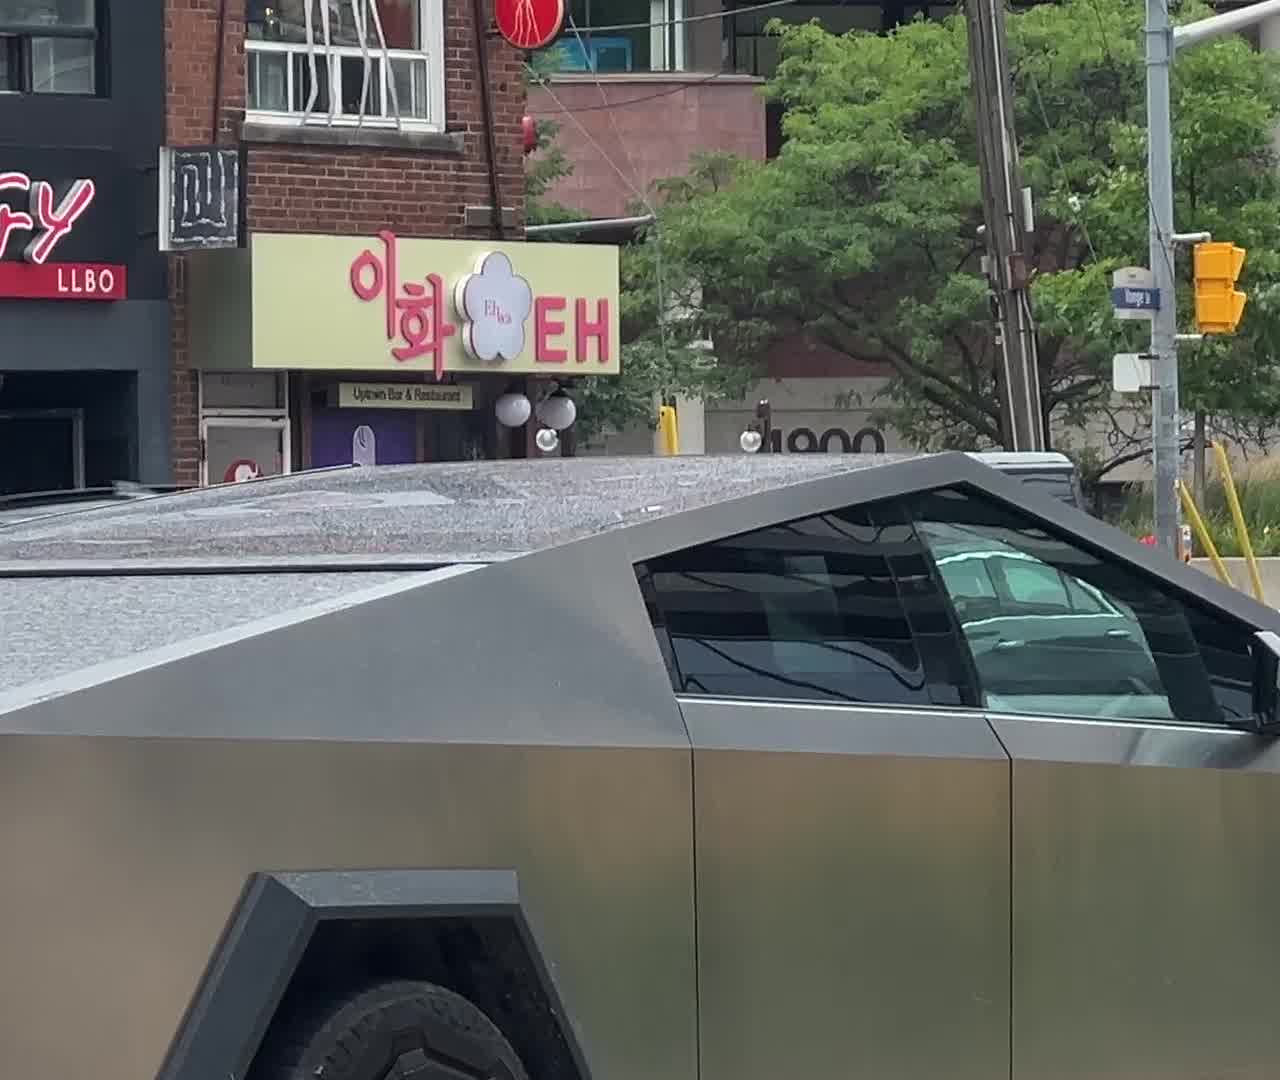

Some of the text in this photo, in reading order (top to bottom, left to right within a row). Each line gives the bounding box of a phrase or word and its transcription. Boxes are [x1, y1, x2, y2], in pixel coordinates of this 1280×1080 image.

[58, 268, 114, 292] LLBO
[350, 230, 456, 381] 이화
[535, 296, 609, 362] EH
